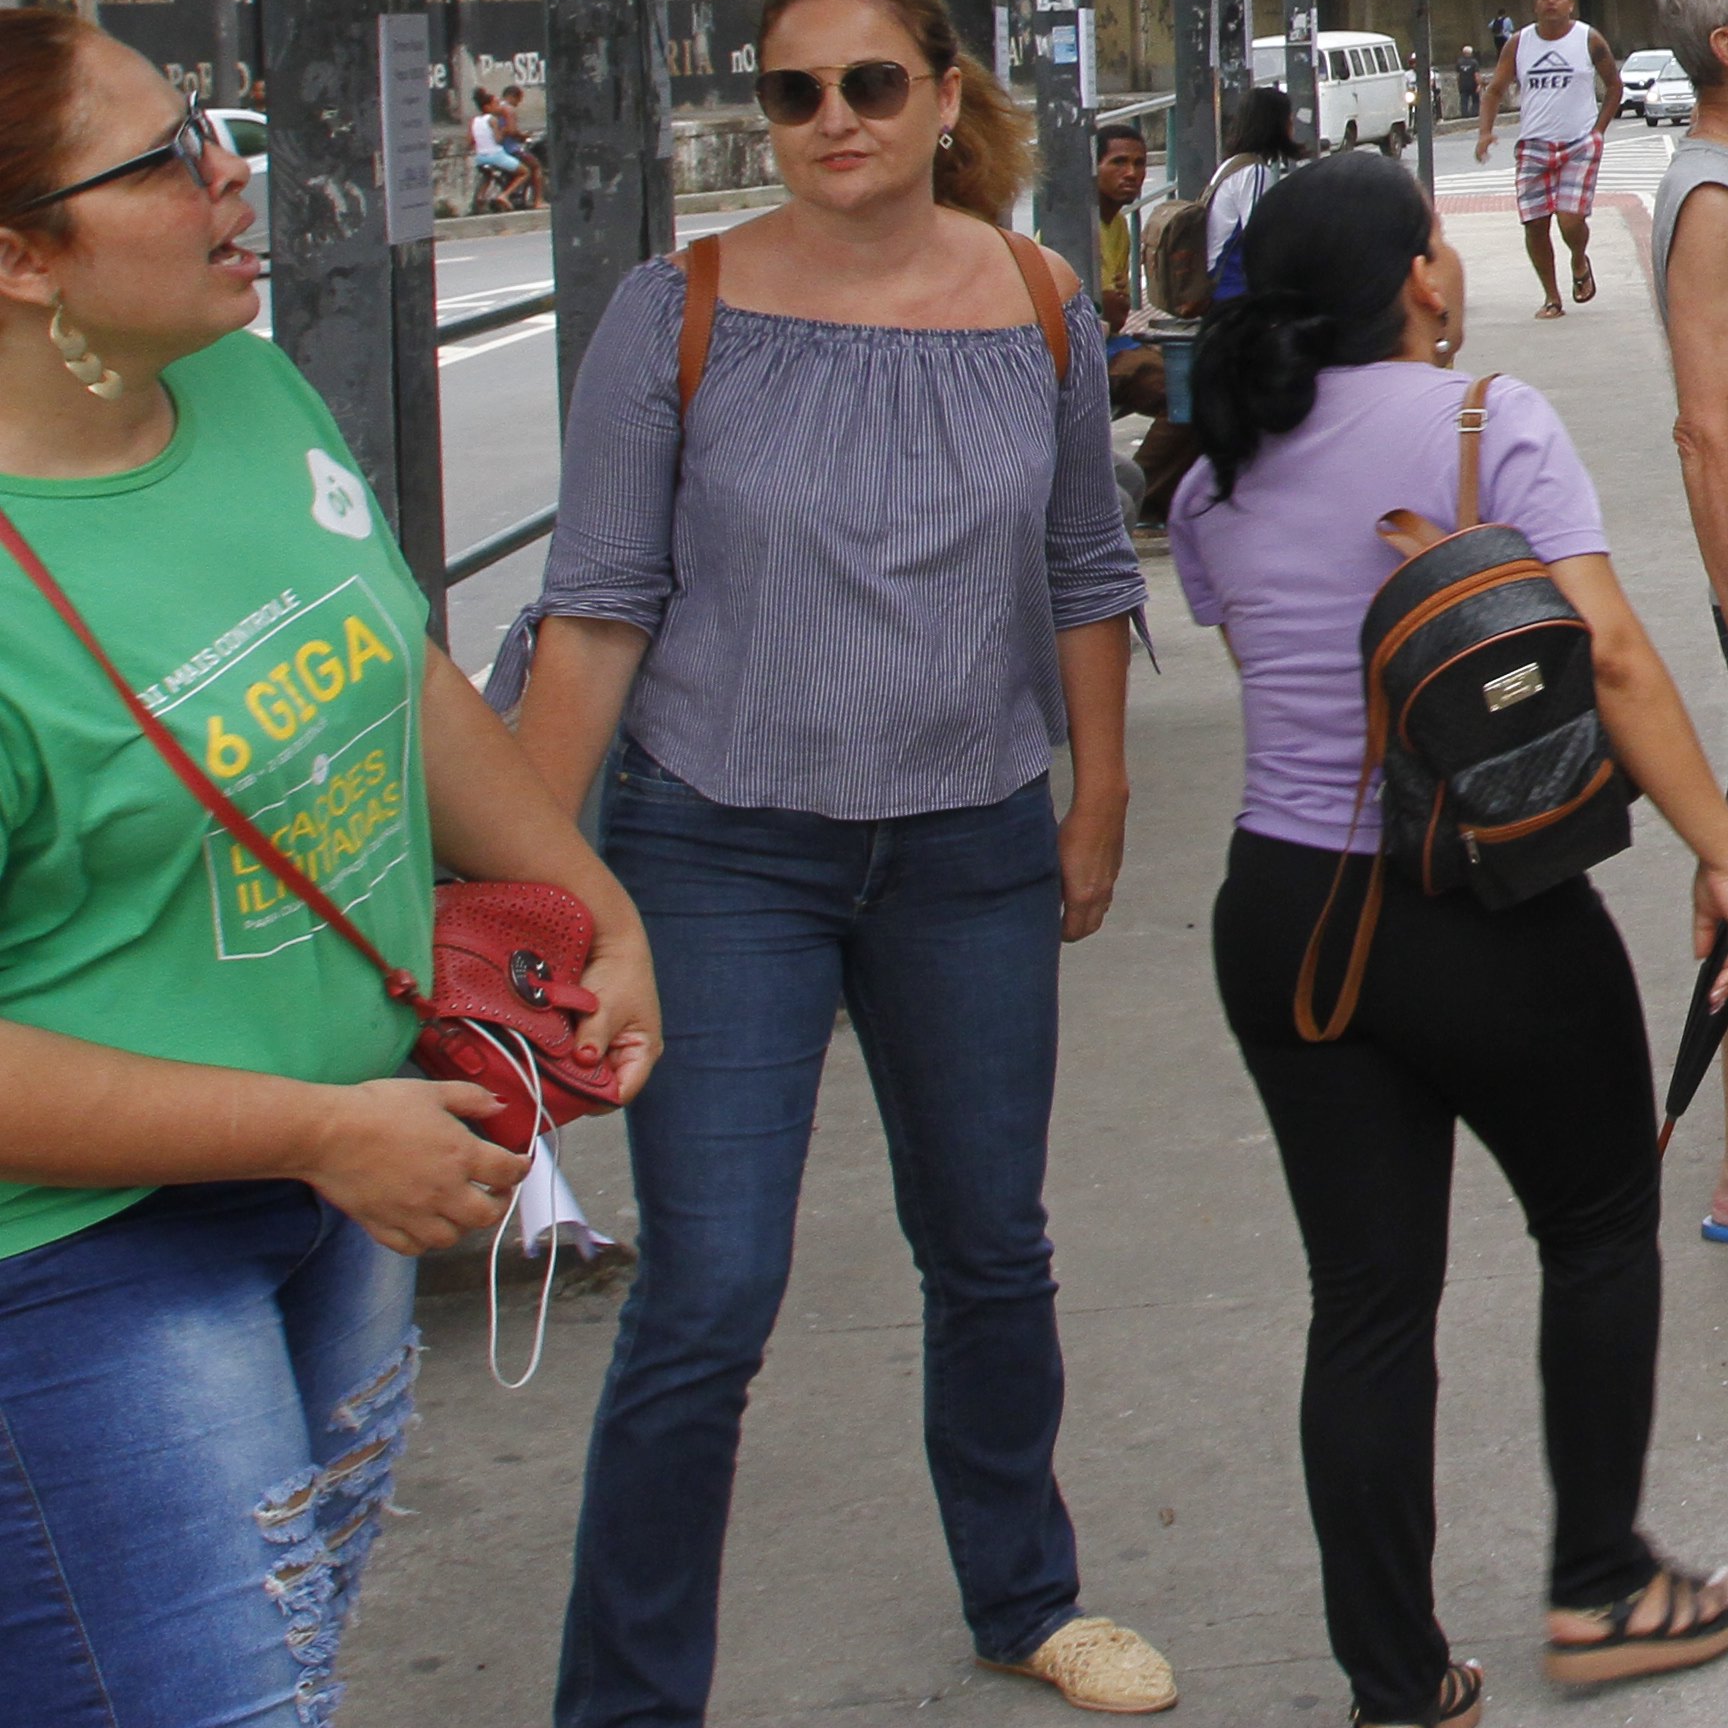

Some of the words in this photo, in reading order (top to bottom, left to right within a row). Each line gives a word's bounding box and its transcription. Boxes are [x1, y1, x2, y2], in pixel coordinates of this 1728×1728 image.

[1530, 76, 1573, 90] REEF
[206, 715, 252, 779] 6
[245, 614, 394, 740] GIGA
